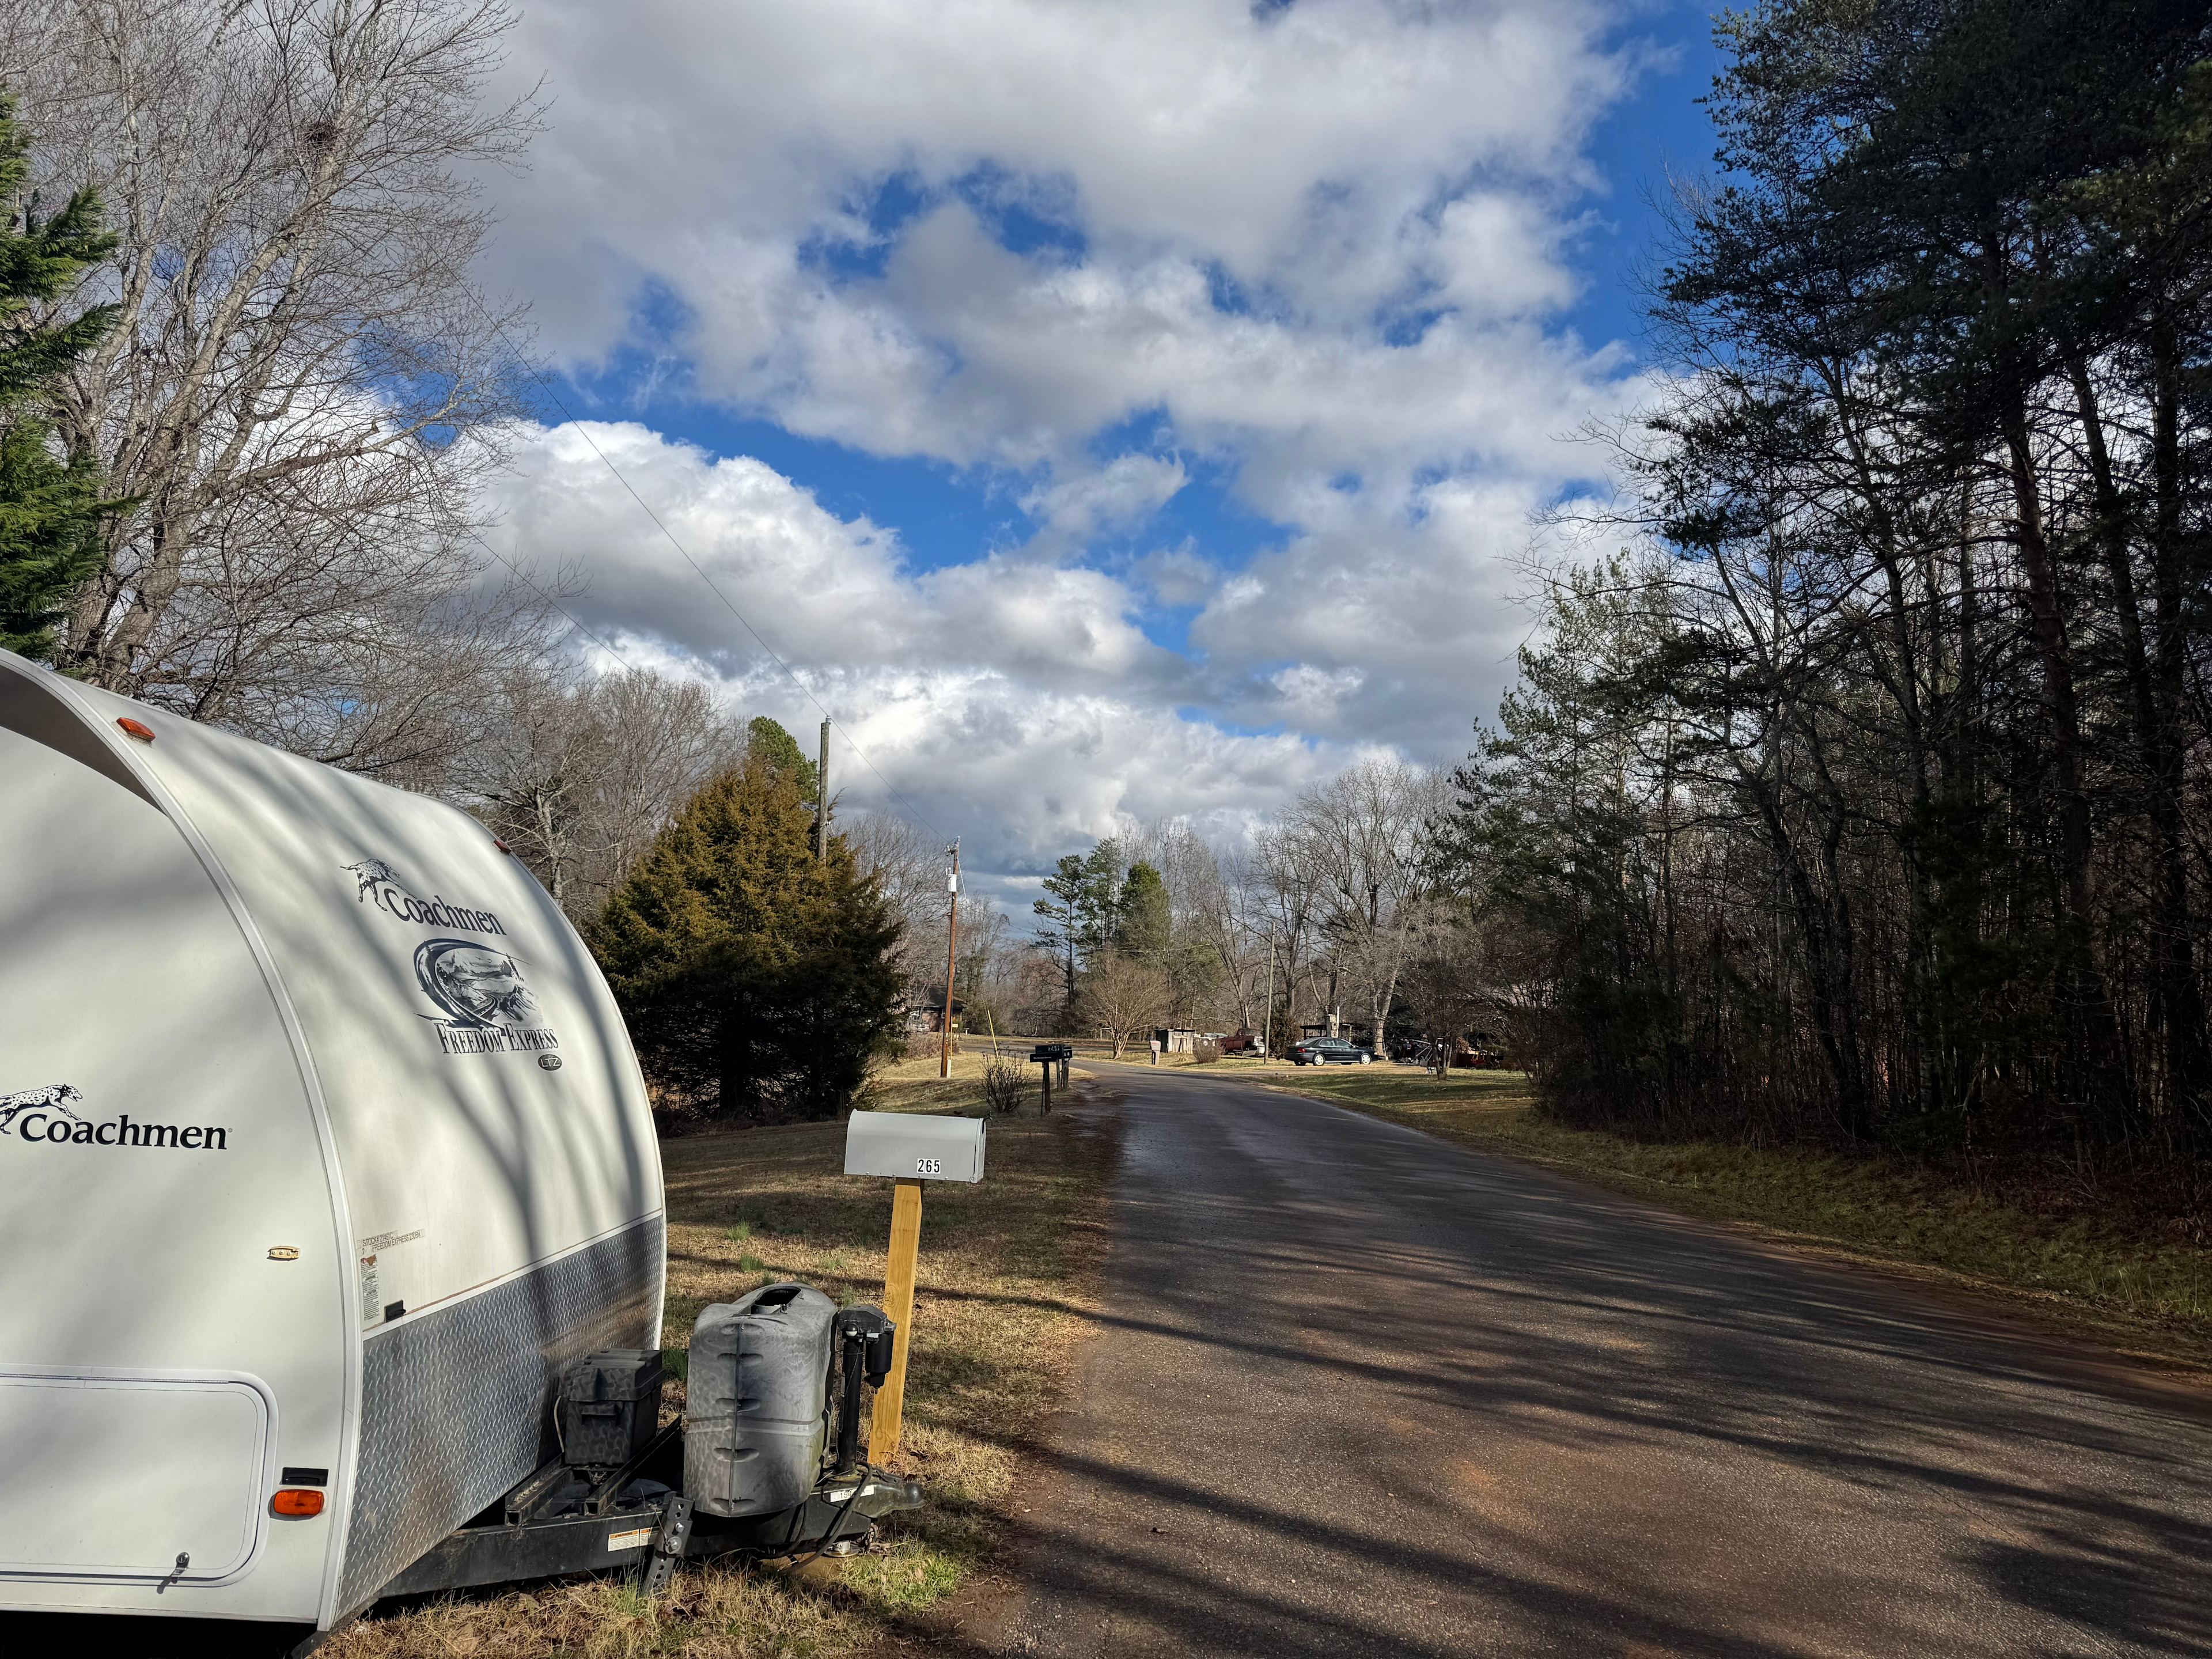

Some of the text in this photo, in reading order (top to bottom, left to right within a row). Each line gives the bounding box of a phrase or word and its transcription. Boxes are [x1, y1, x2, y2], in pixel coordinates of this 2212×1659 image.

[384, 888, 507, 935] Coachmen
[433, 1023, 559, 1054] FREEDOM EXPRESS
[540, 1058, 560, 1067] LTZ
[20, 1113, 227, 1150] Coachmen
[918, 1159, 940, 1173] 265
